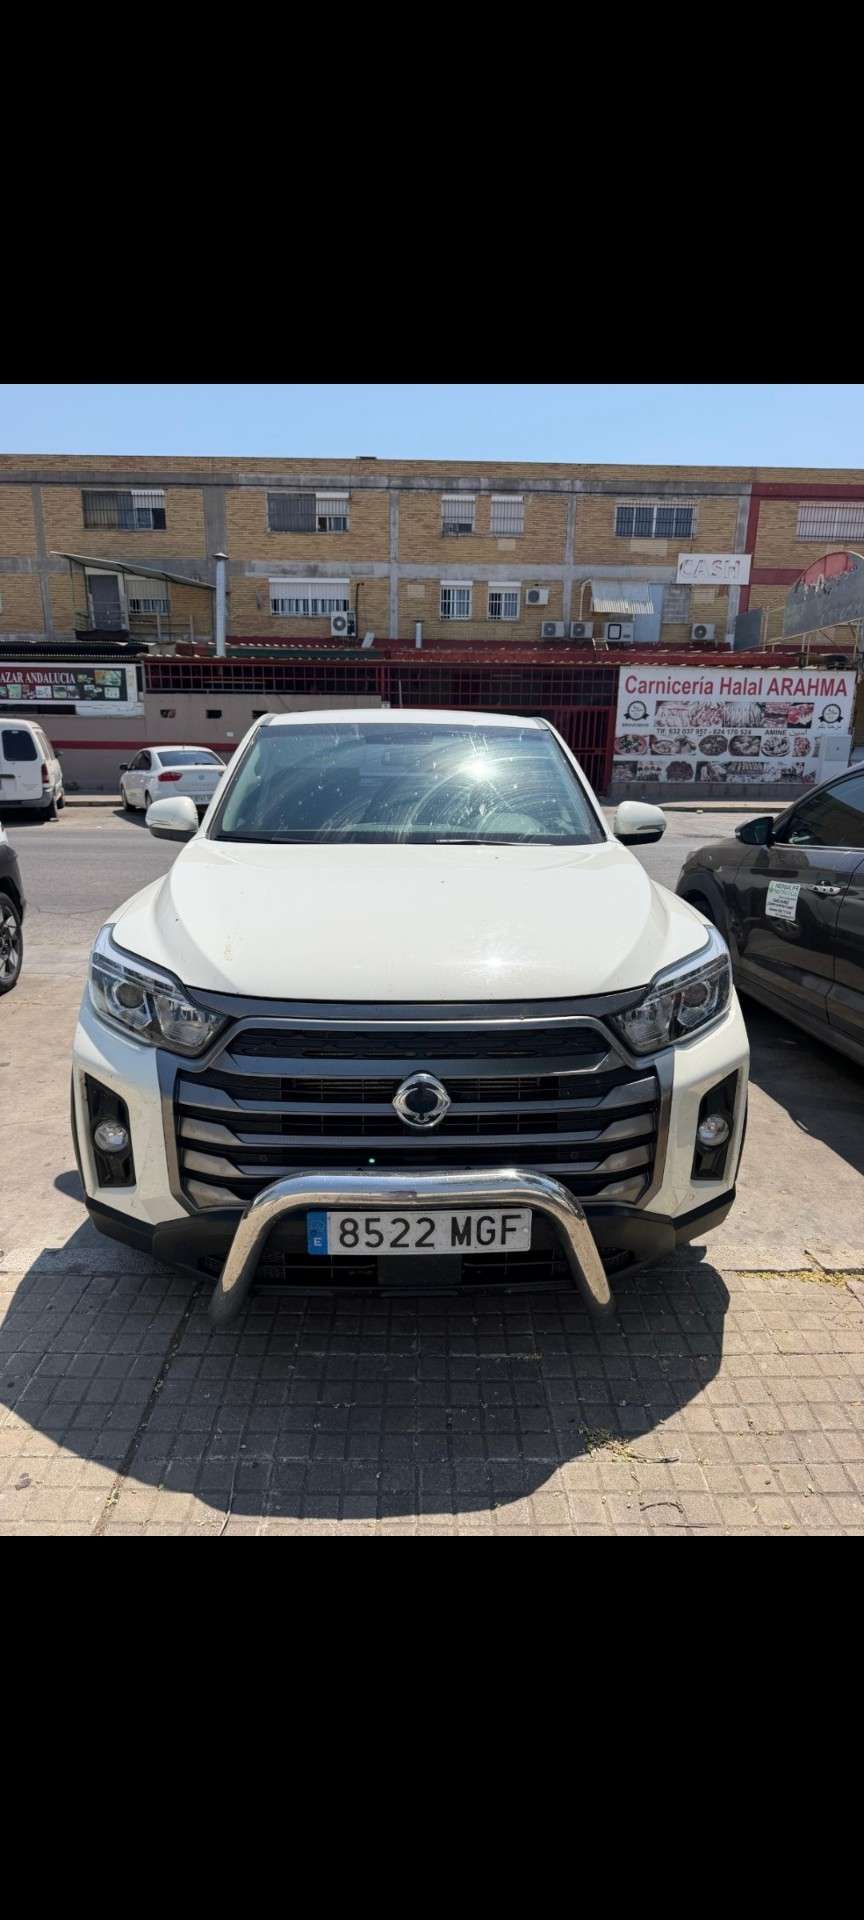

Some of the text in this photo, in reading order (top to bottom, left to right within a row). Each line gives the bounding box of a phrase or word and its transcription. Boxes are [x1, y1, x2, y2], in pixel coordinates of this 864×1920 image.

[680, 559, 740, 579] CASH
[0, 671, 23, 683] AZAR
[625, 675, 848, 697] Carnicería Halal ARAHMA
[339, 1214, 522, 1248] 8522 MGF
[313, 1237, 322, 1246] E
